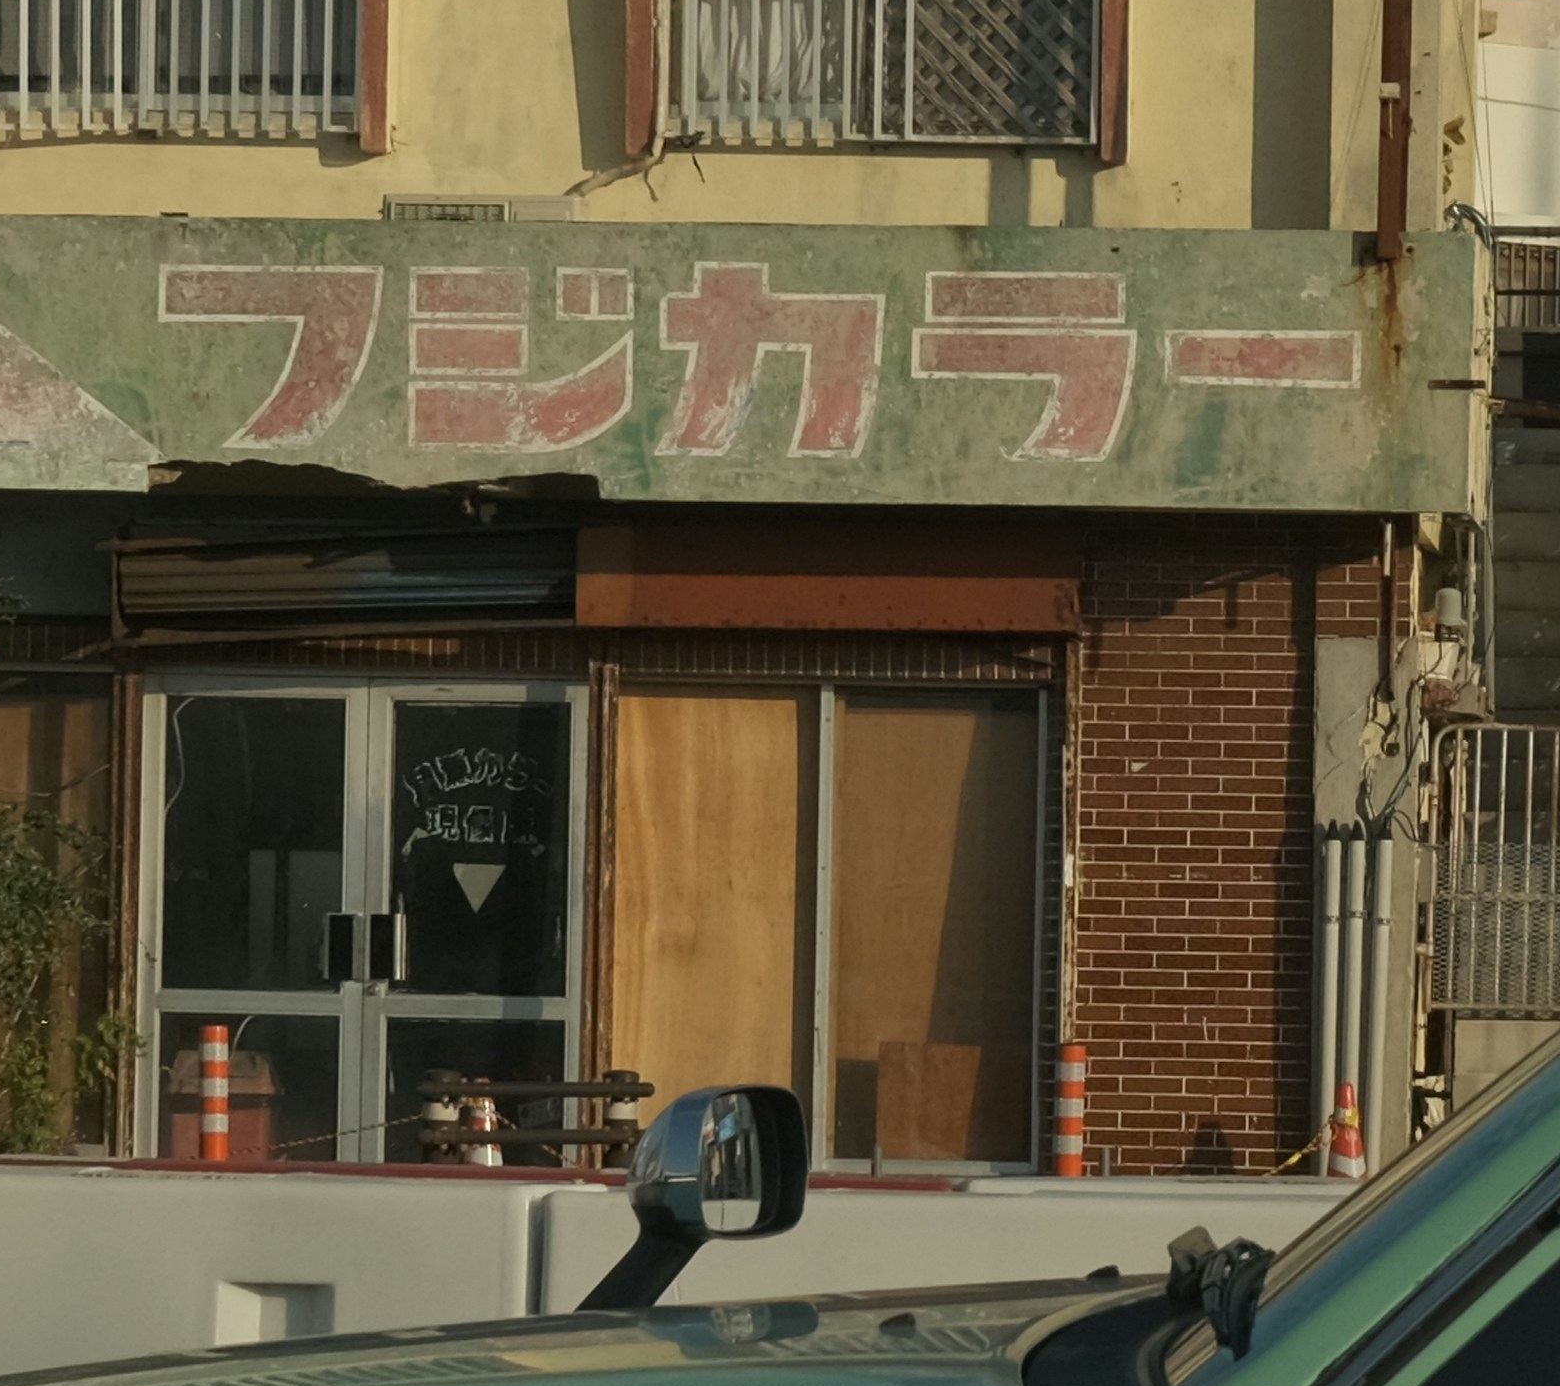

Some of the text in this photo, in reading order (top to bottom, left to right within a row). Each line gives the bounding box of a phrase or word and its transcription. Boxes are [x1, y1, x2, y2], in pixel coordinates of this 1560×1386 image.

[157, 261, 1364, 462] フジカラー
